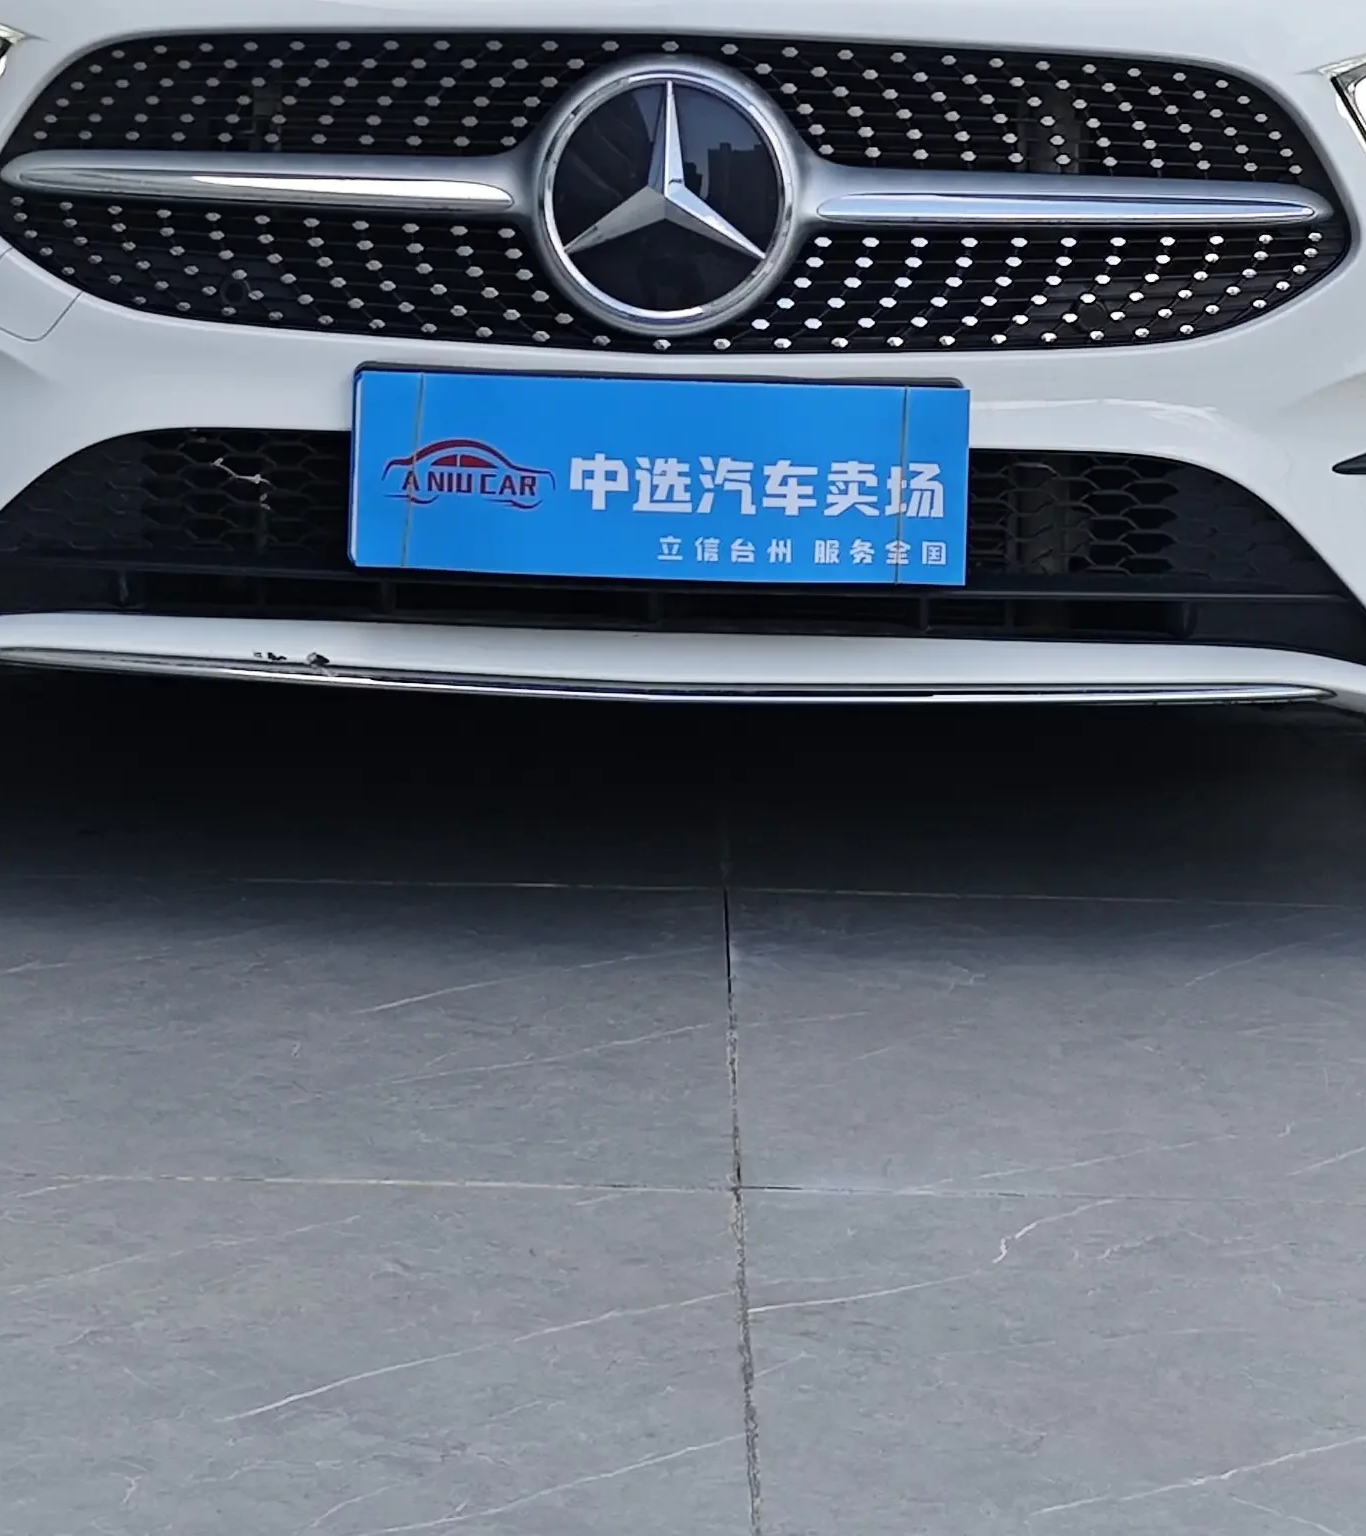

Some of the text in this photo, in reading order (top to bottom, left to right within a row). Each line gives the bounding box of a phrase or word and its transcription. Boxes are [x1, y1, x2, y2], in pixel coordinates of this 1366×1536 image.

[480, 473, 537, 496] CAR
[569, 453, 944, 518] 中选汽车卖场
[657, 535, 947, 566] 立信台州 服务全国
